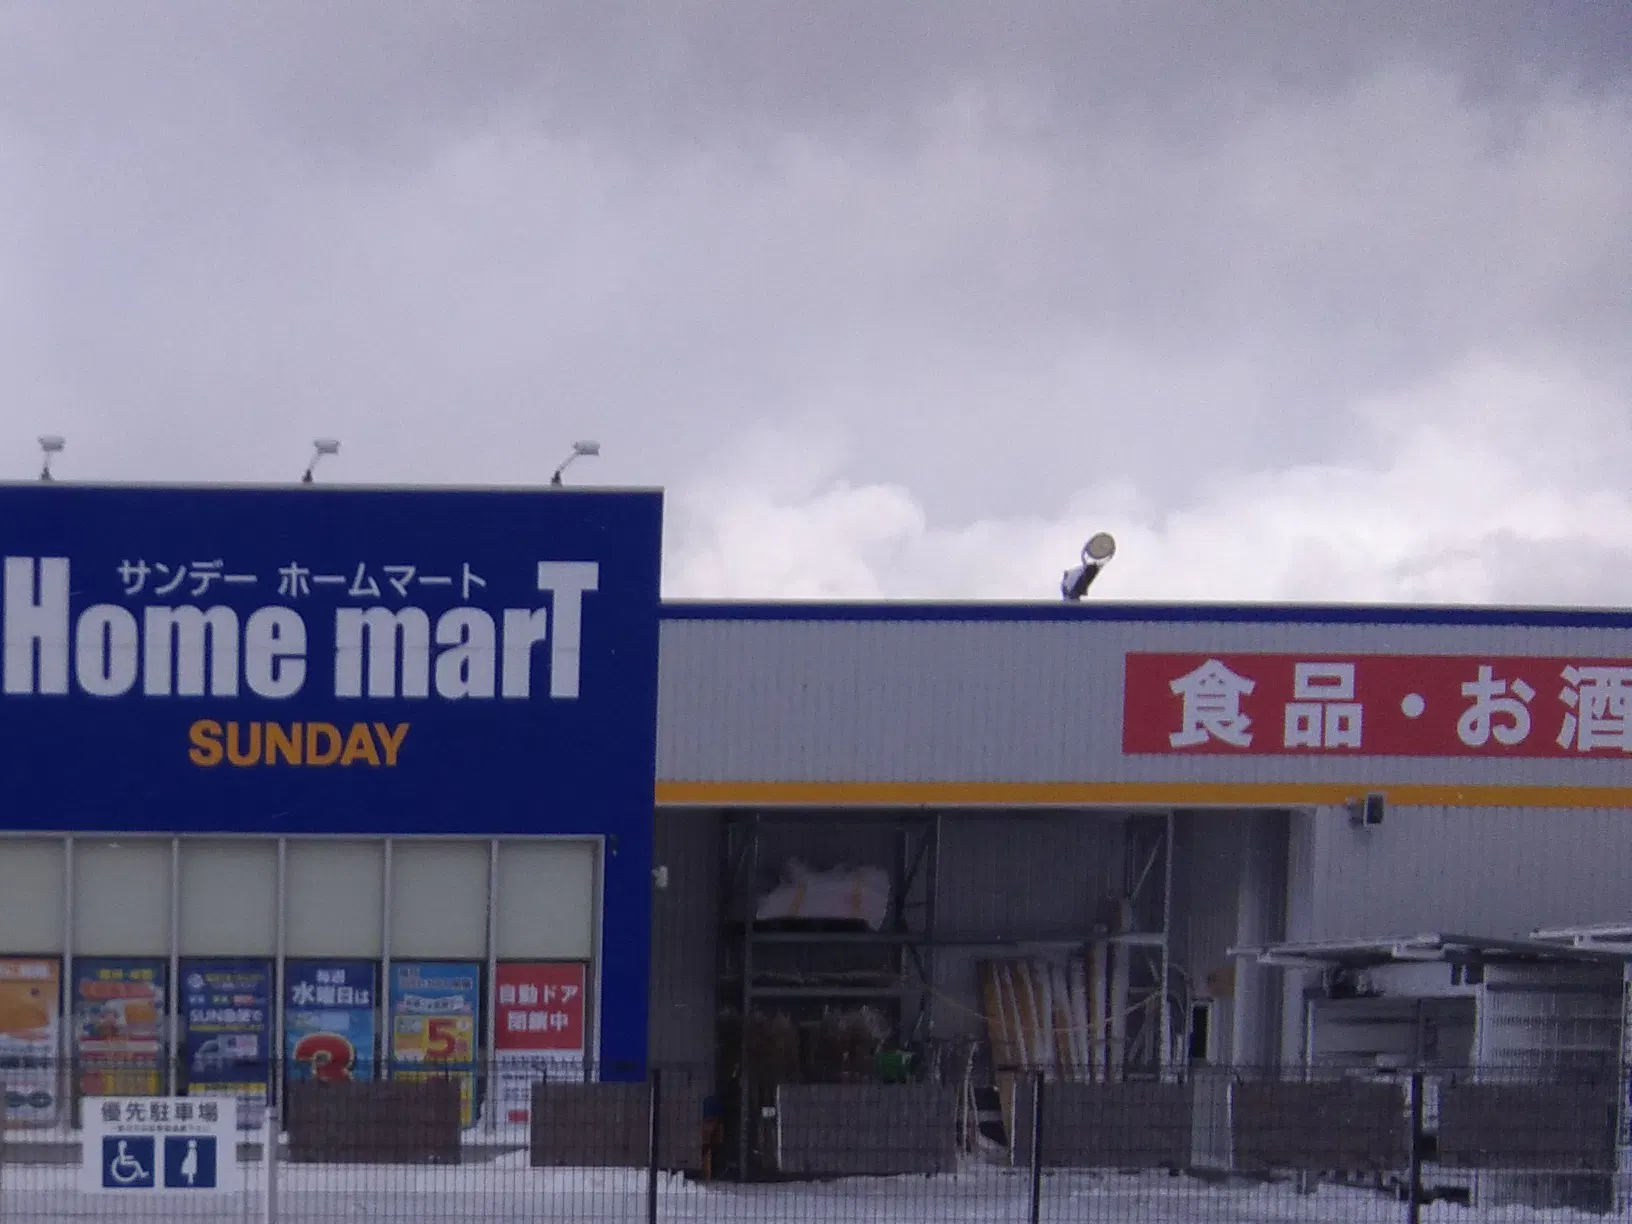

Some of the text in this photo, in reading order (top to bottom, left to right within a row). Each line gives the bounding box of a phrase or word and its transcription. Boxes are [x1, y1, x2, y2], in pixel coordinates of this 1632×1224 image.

[117, 558, 487, 599] サンデー ホームマート
[2, 556, 308, 698] Home
[1169, 658, 1632, 752] 食品・お酒
[188, 719, 410, 767] SUNDAY
[291, 980, 370, 1006] 水曜日は
[499, 983, 579, 1006] 自動ドア
[426, 1017, 458, 1061] 5
[101, 1101, 219, 1123] 優先駐車場
